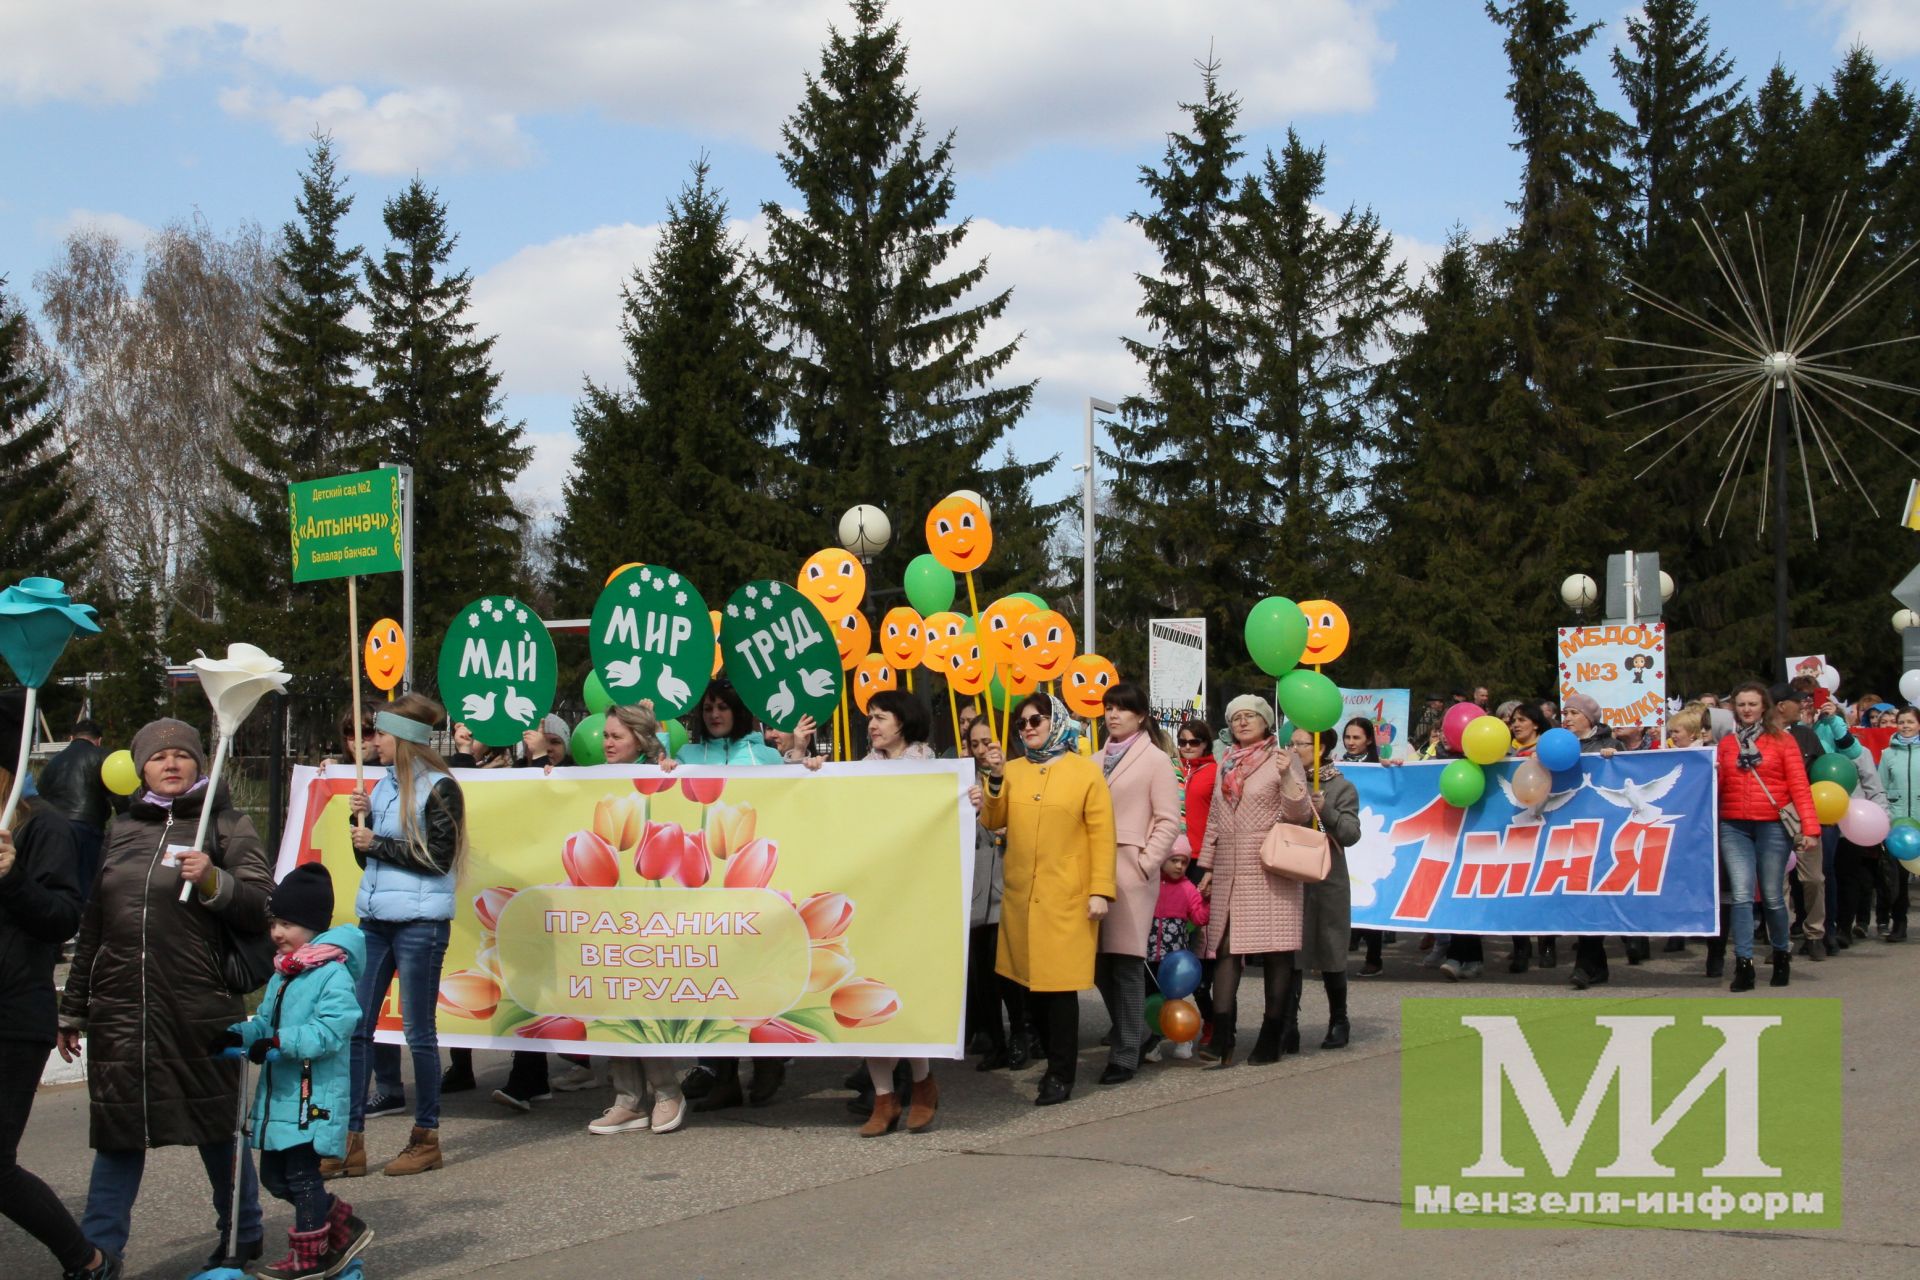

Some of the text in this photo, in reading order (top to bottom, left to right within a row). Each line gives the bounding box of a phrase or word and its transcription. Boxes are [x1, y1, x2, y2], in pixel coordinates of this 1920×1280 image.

[312, 480, 371, 502] Детский сад №2
[300, 512, 389, 540] «Алтынчәч»
[311, 546, 378, 563] Балалар бакчасы
[603, 605, 692, 656] МИР
[735, 606, 823, 679] ТРУД
[1560, 626, 1663, 658] МБДОУ
[459, 630, 537, 682] МАЙ
[1576, 662, 1618, 682] №3
[1561, 681, 1665, 727] ЧРАШКА
[1389, 793, 1676, 921] 1 МАЯ
[544, 909, 761, 937] ПРАЗДНИК
[580, 943, 719, 967] ВЕСНЫ
[569, 975, 739, 1003] И ТРУДА
